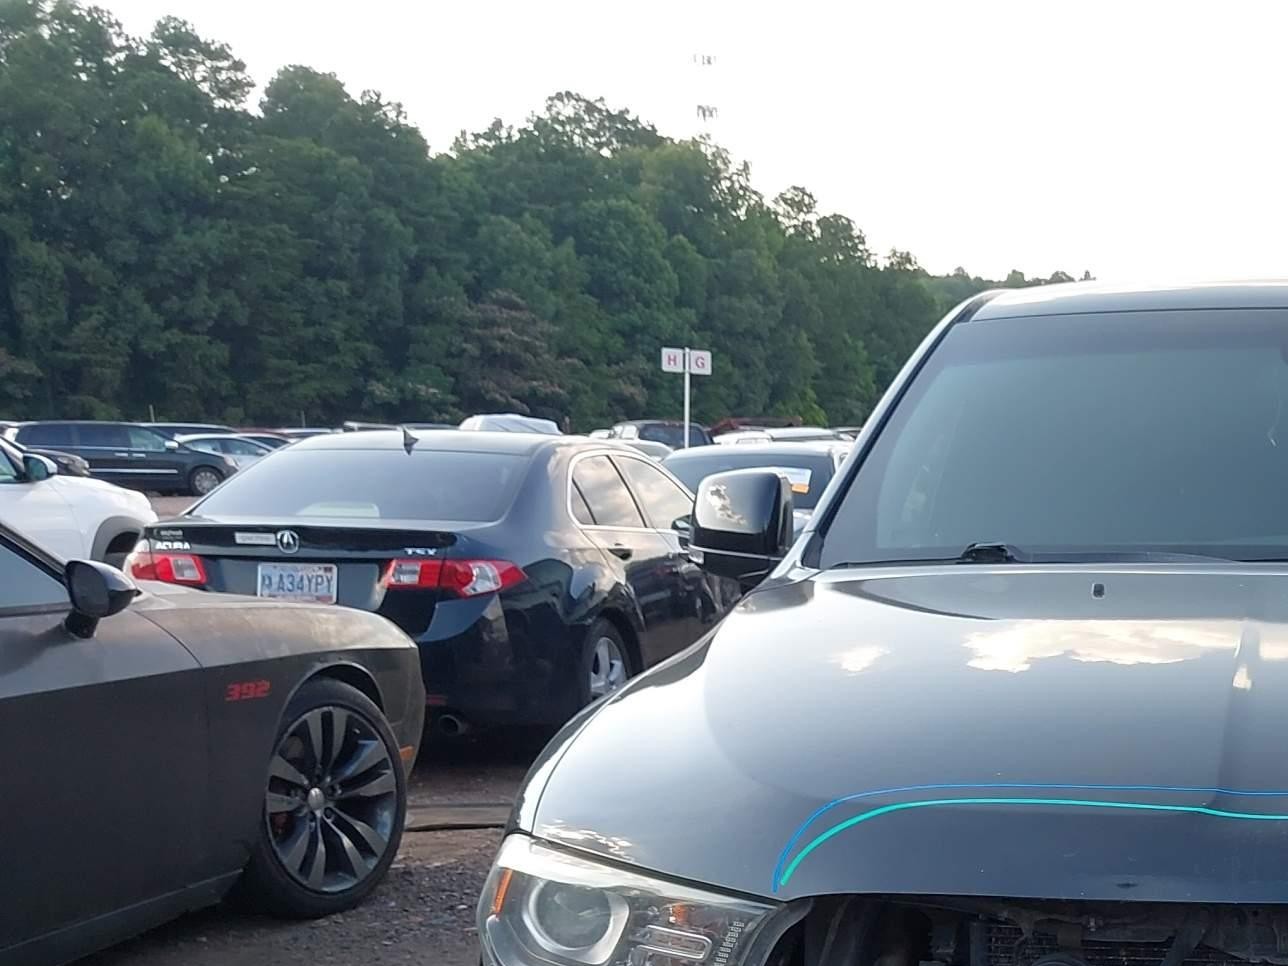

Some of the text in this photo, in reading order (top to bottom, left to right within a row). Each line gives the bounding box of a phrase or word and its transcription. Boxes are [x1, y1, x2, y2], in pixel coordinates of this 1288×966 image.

[667, 354, 677, 367] H
[695, 356, 705, 369] G
[225, 679, 271, 701] 392
